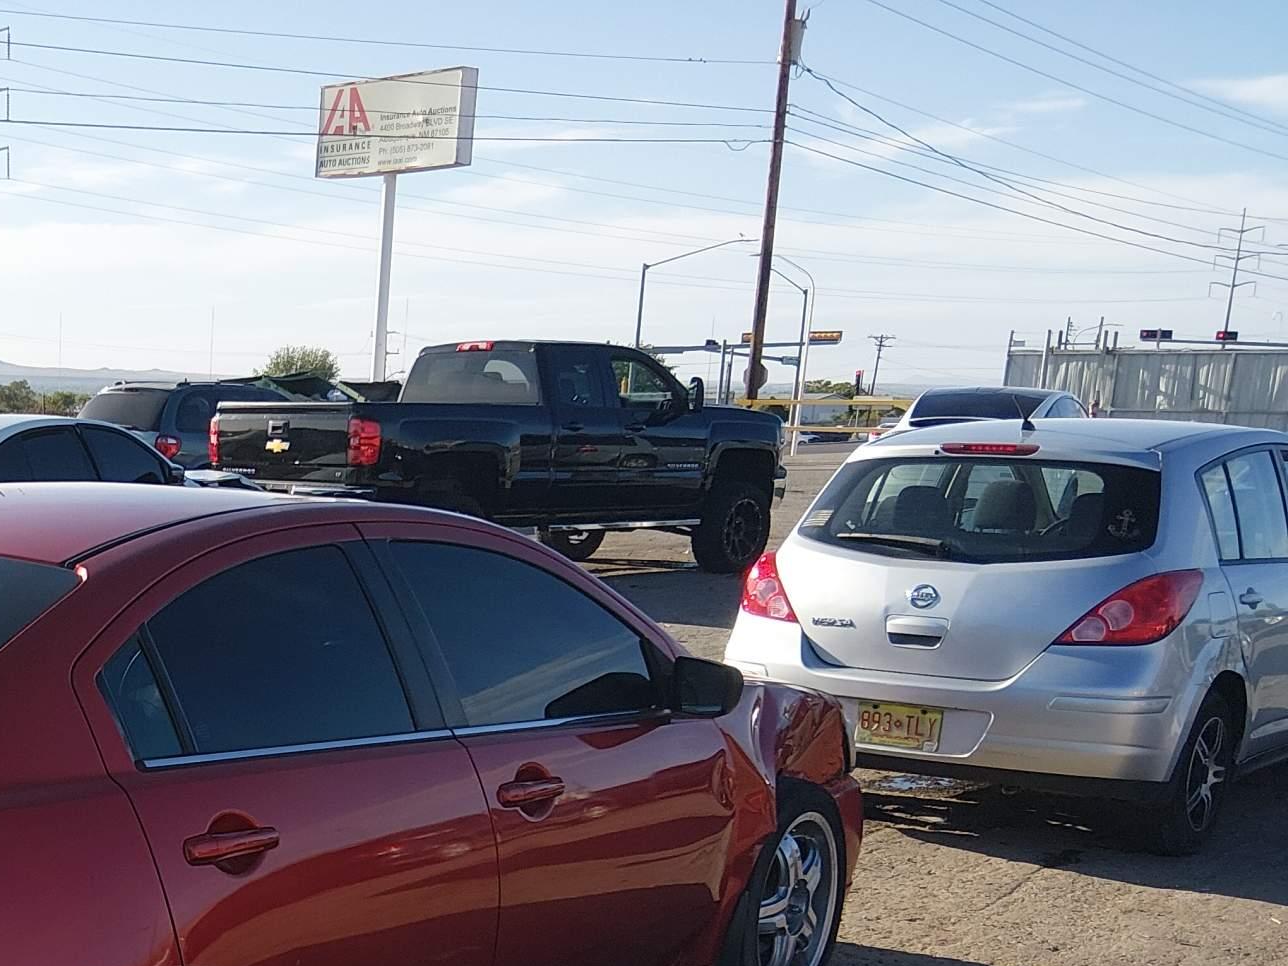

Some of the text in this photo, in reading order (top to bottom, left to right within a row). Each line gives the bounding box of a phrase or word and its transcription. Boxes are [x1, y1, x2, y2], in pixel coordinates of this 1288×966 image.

[428, 106, 457, 116] Auctions
[319, 140, 372, 155] INSURANCE
[319, 154, 371, 169] AUTO AUCTIONS
